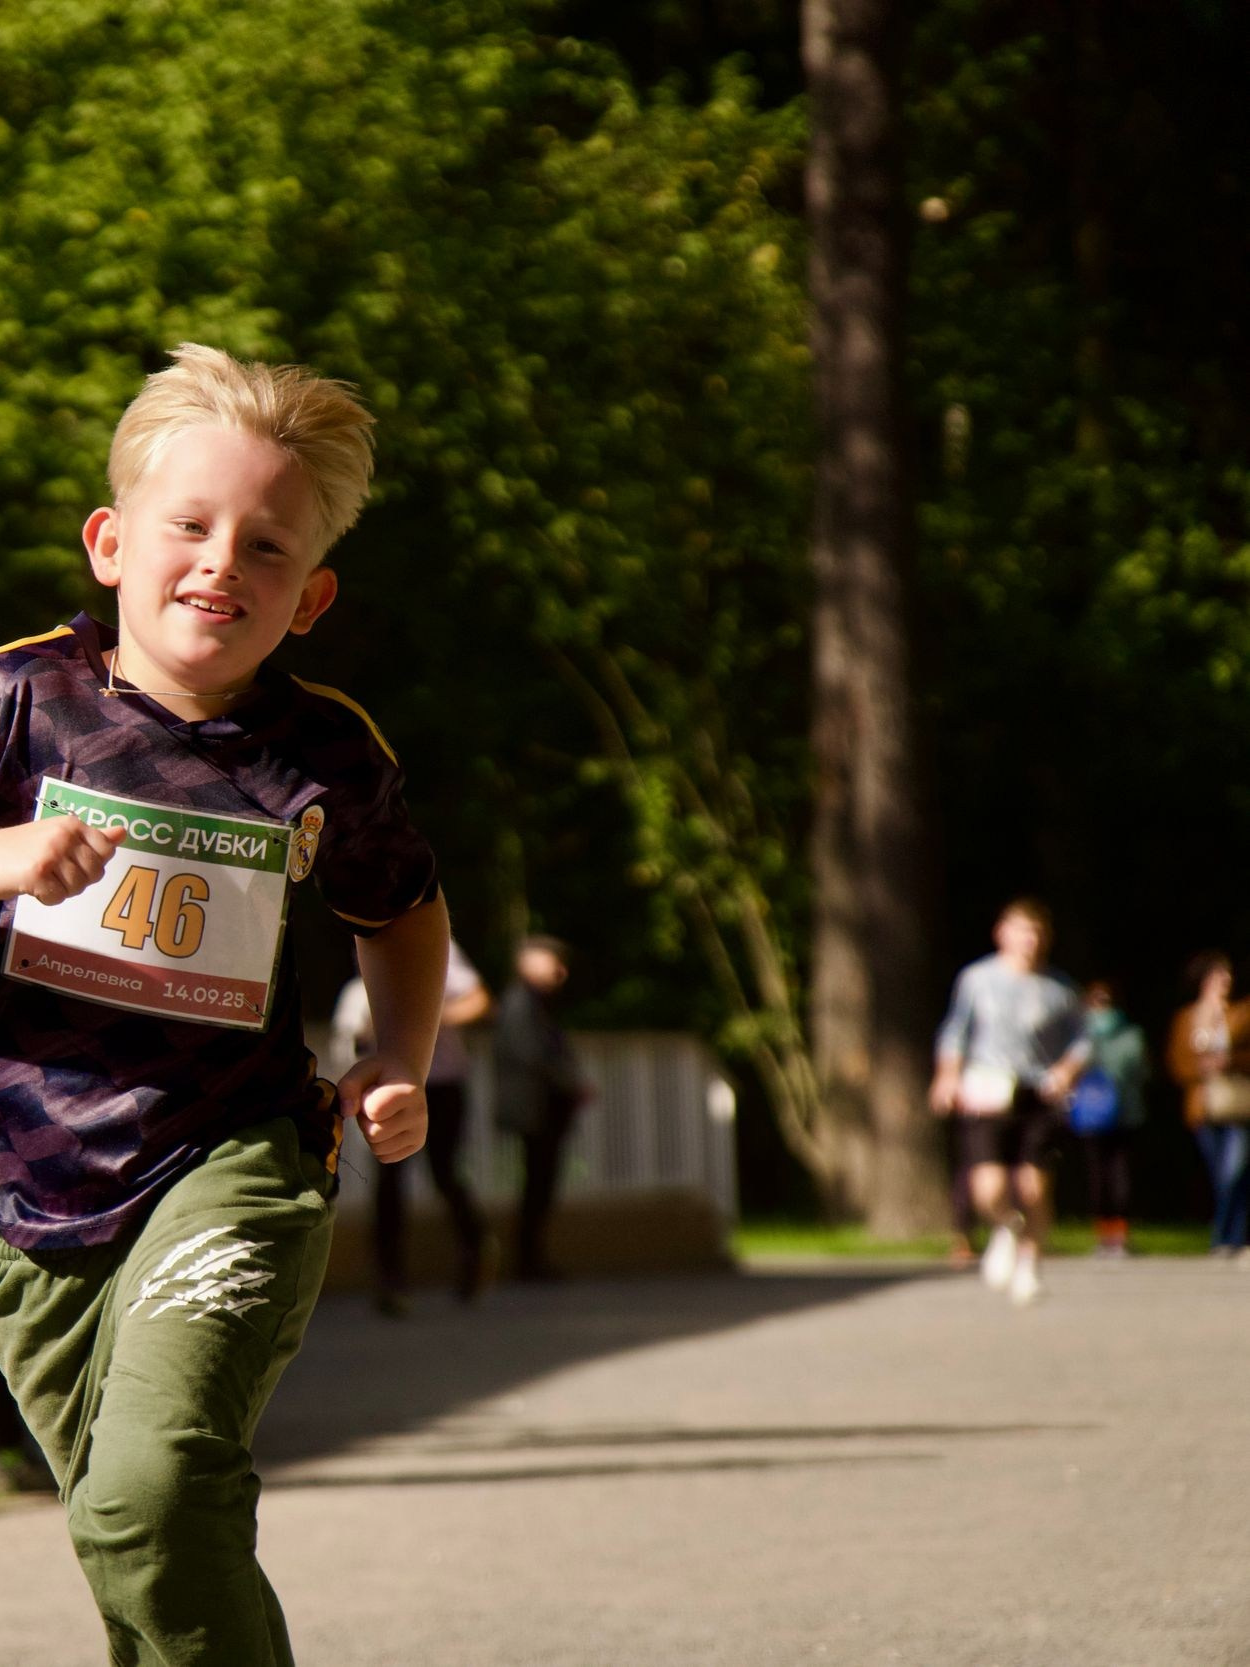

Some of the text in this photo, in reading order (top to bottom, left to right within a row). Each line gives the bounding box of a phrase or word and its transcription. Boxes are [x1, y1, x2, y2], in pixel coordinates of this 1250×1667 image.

[177, 827, 269, 861] ДУБКИ
[101, 864, 210, 959] 46
[37, 953, 245, 1009] Апрелевка 14.09.25
